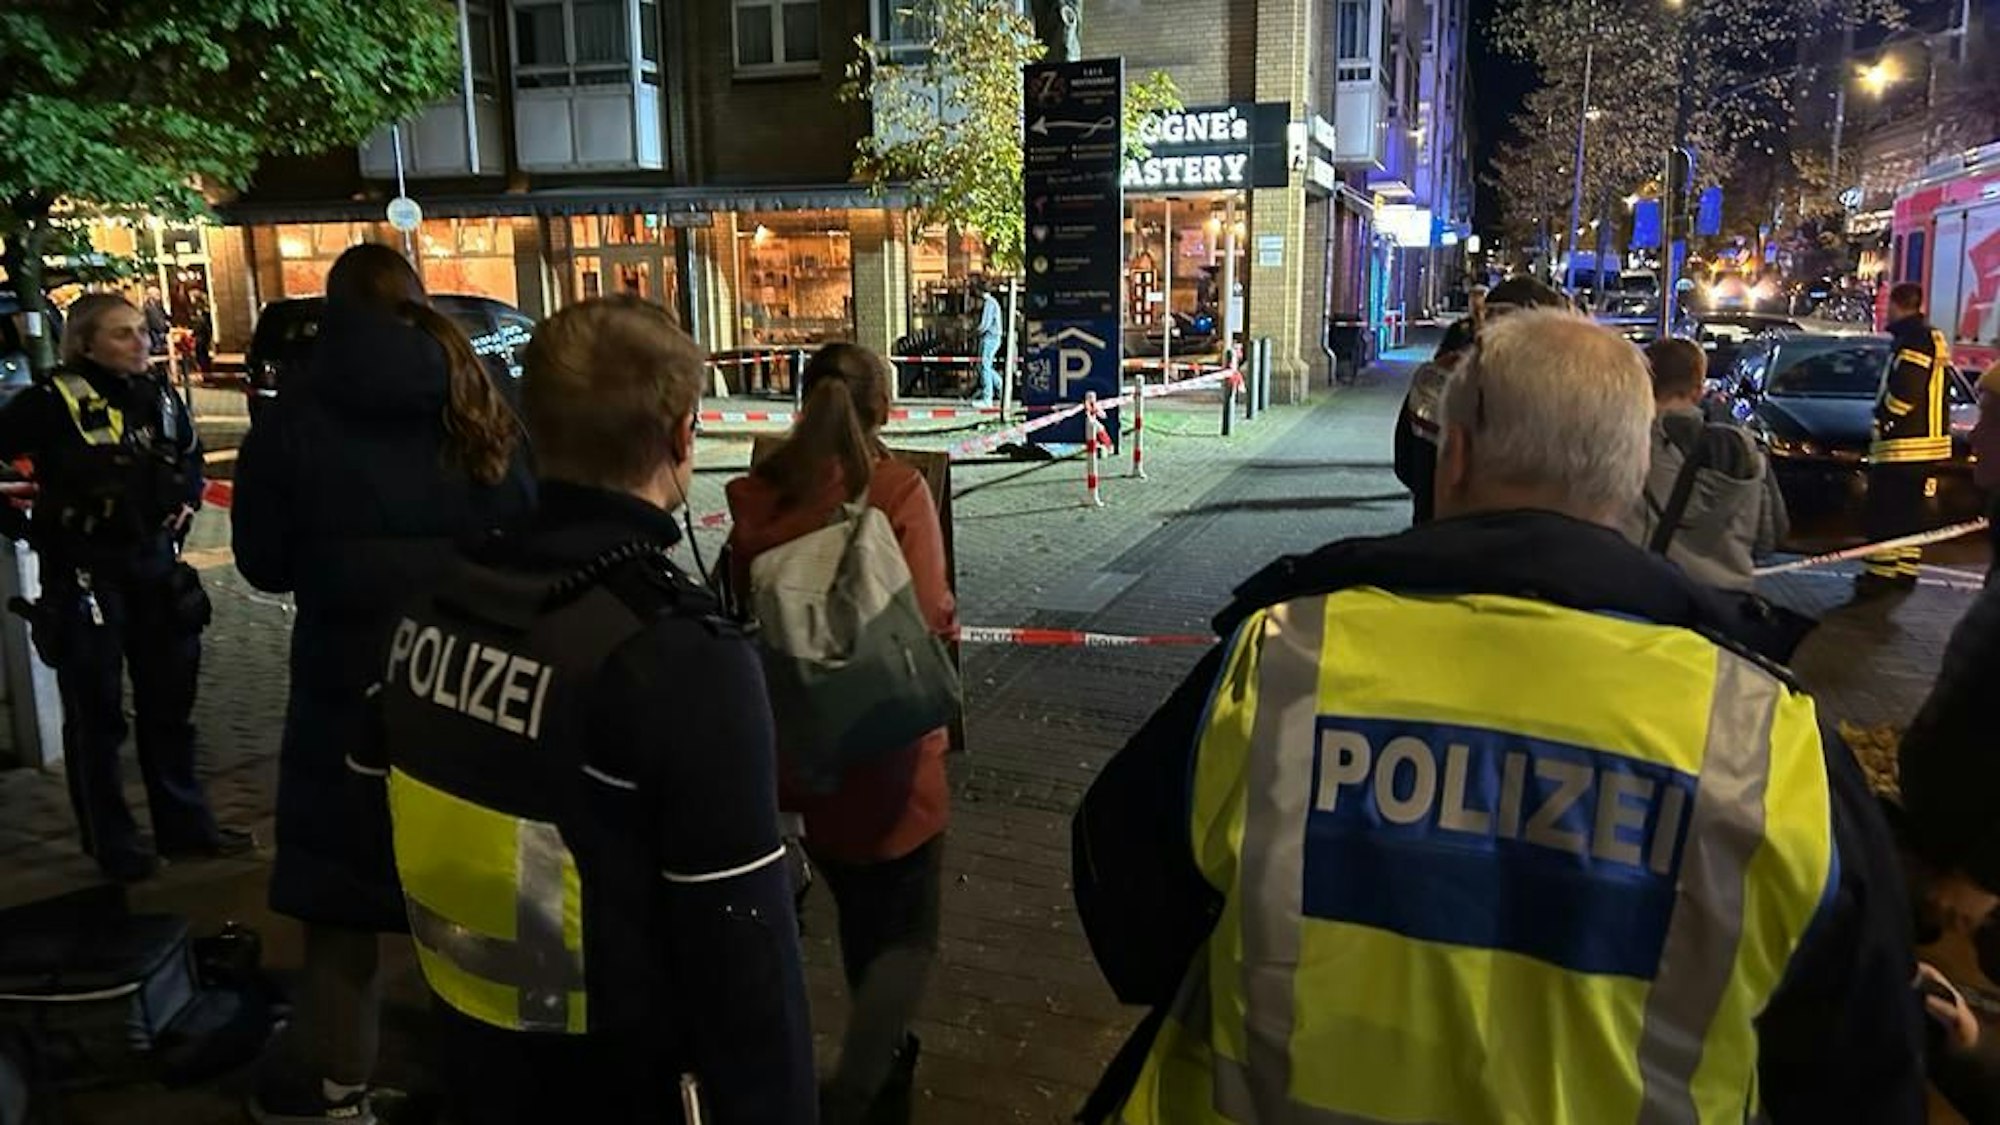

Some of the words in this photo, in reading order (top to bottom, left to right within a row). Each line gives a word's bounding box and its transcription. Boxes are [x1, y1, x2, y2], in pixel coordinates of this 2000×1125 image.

[1123, 153, 1248, 186] ASTERY
[1059, 348, 1093, 398] P
[386, 615, 553, 740] POLIZEI
[1314, 727, 1686, 876] POLIZEI
